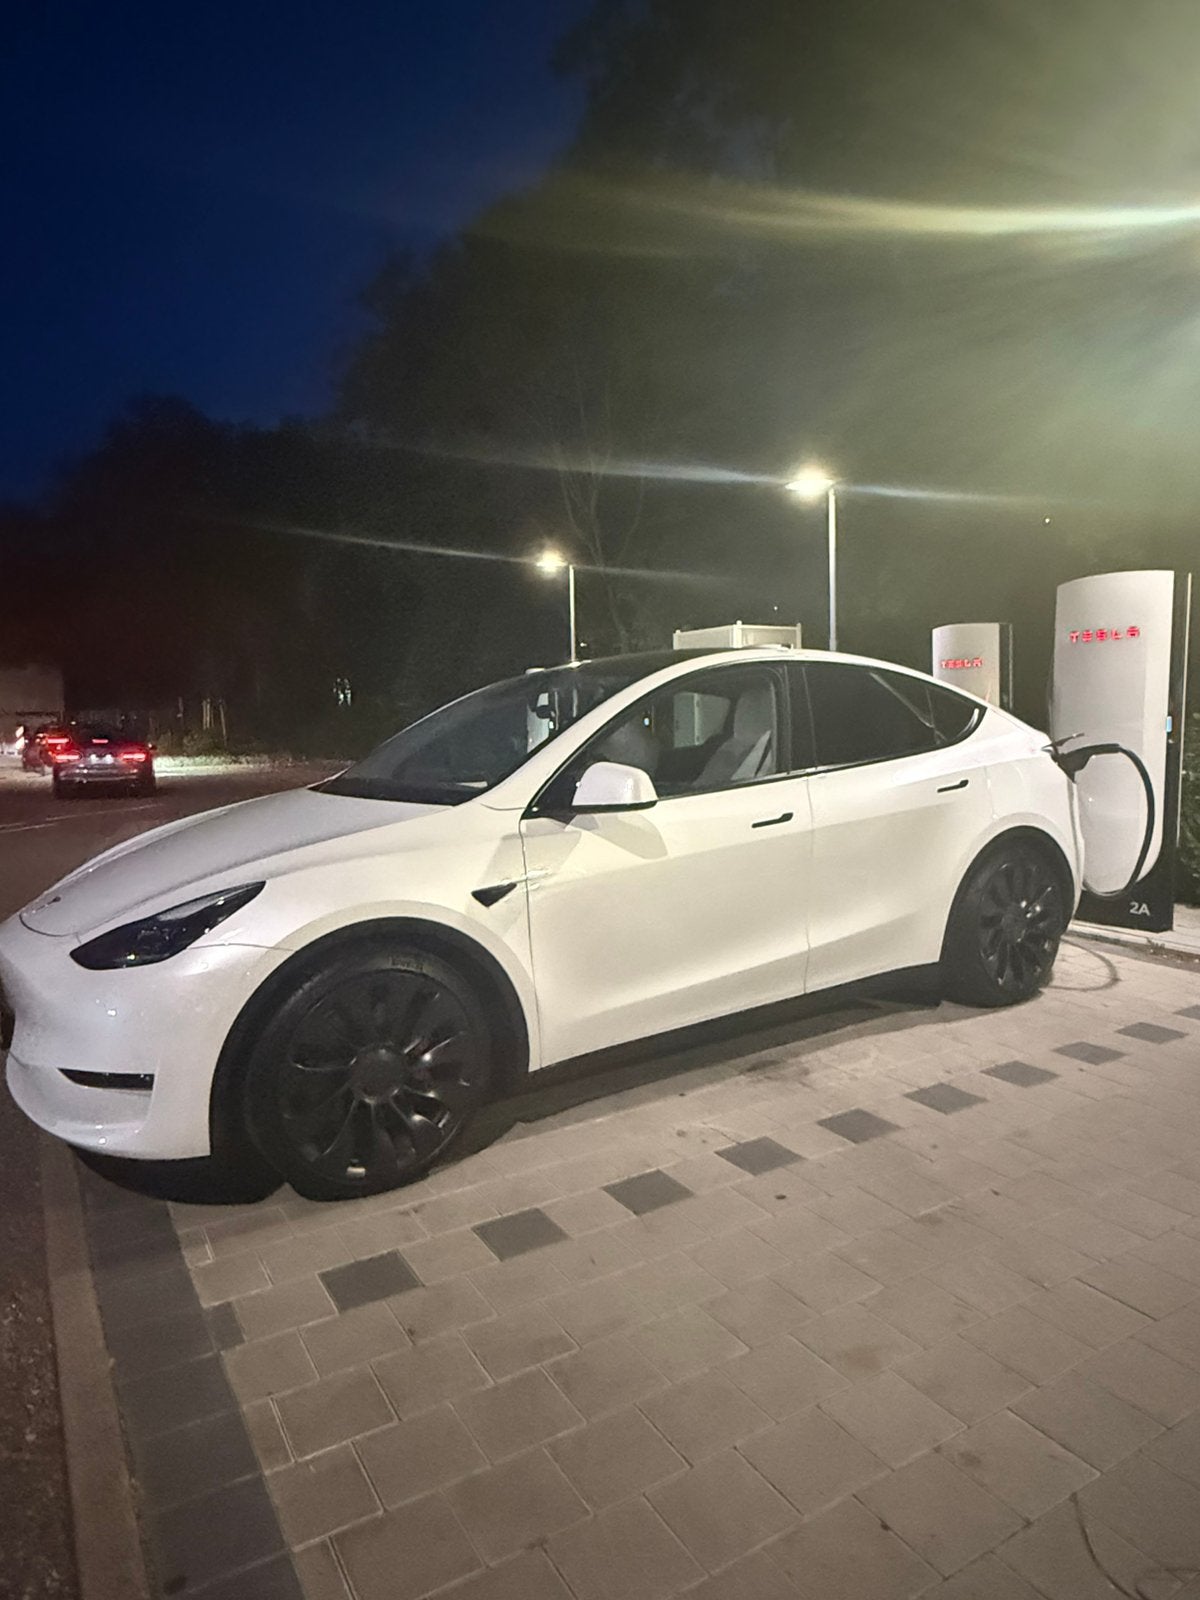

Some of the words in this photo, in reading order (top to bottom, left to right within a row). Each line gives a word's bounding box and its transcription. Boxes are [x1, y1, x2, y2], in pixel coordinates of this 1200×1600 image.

[1069, 625, 1140, 643] TESLA
[940, 657, 984, 670] TESLA
[1129, 901, 1151, 916] 2A
